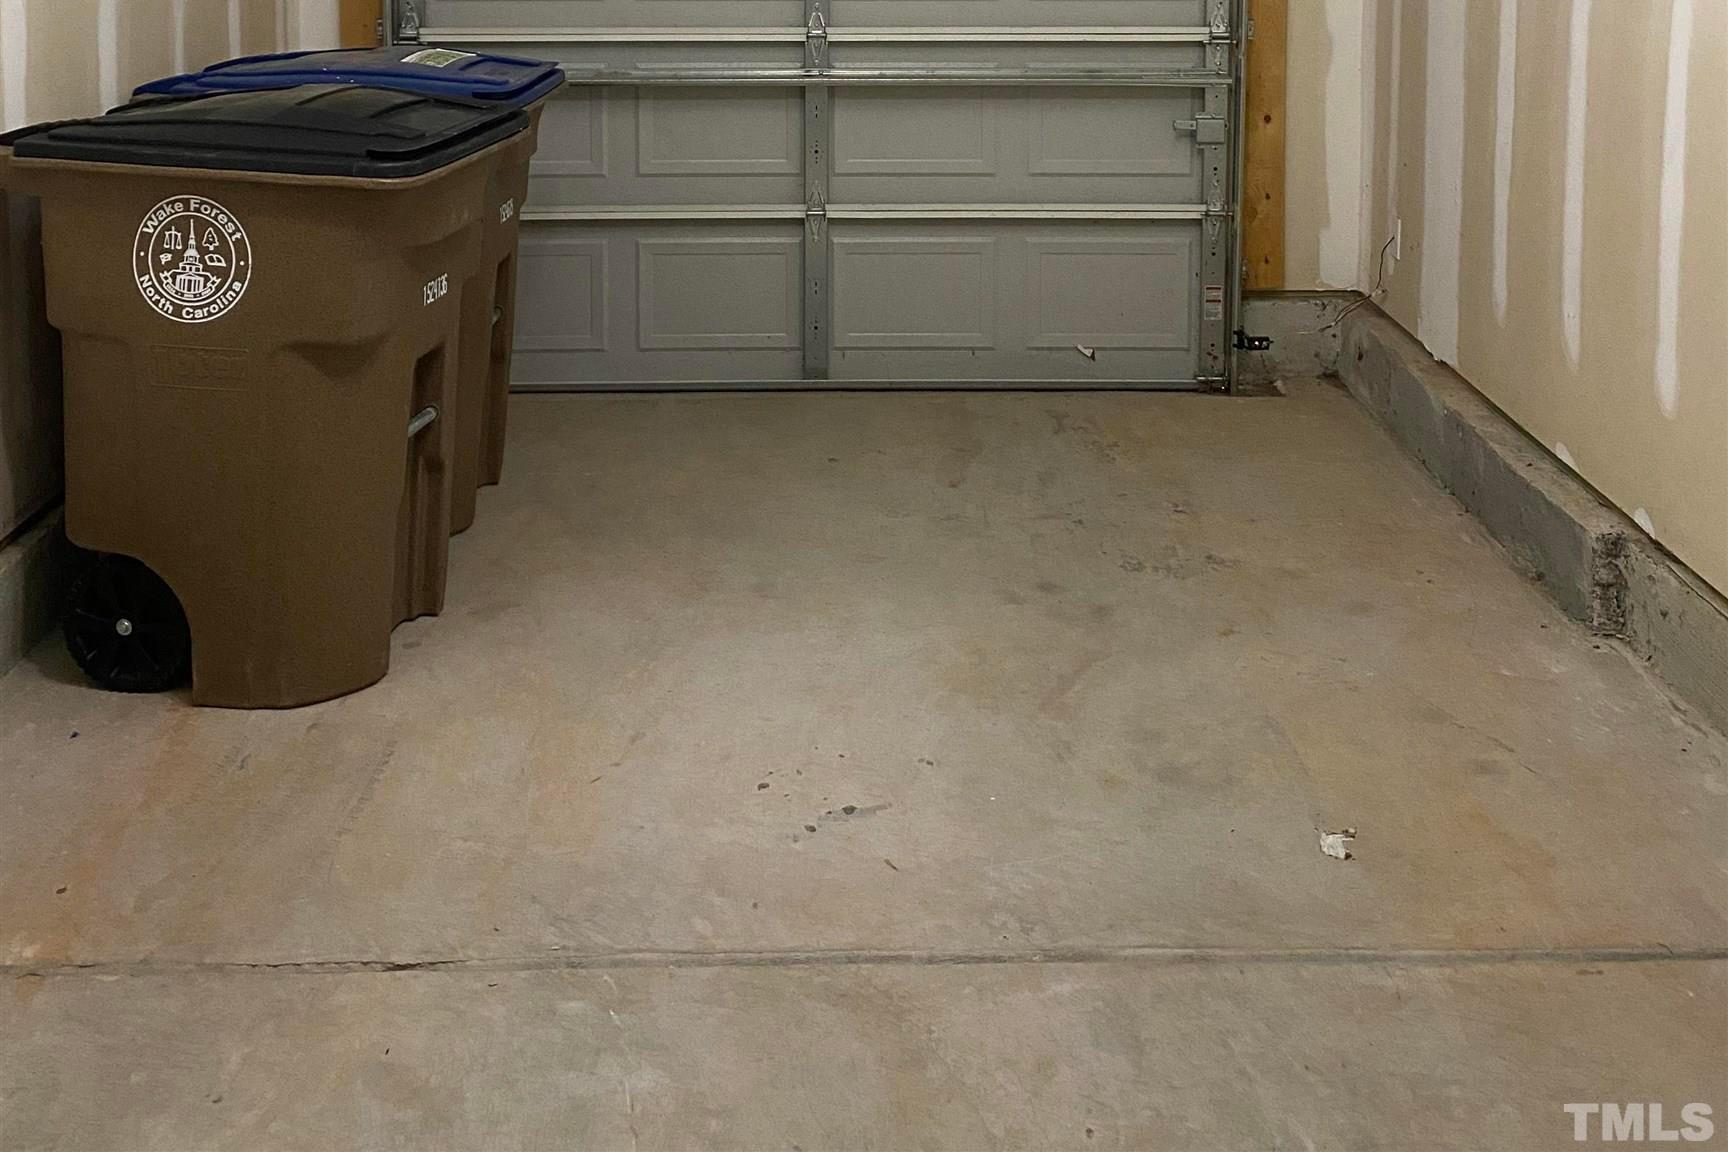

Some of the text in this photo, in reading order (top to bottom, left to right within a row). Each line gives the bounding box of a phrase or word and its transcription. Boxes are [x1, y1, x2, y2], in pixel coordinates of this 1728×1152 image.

[142, 199, 242, 242] Wake Forest
[139, 274, 174, 314] North
[182, 280, 242, 319] Carolina
